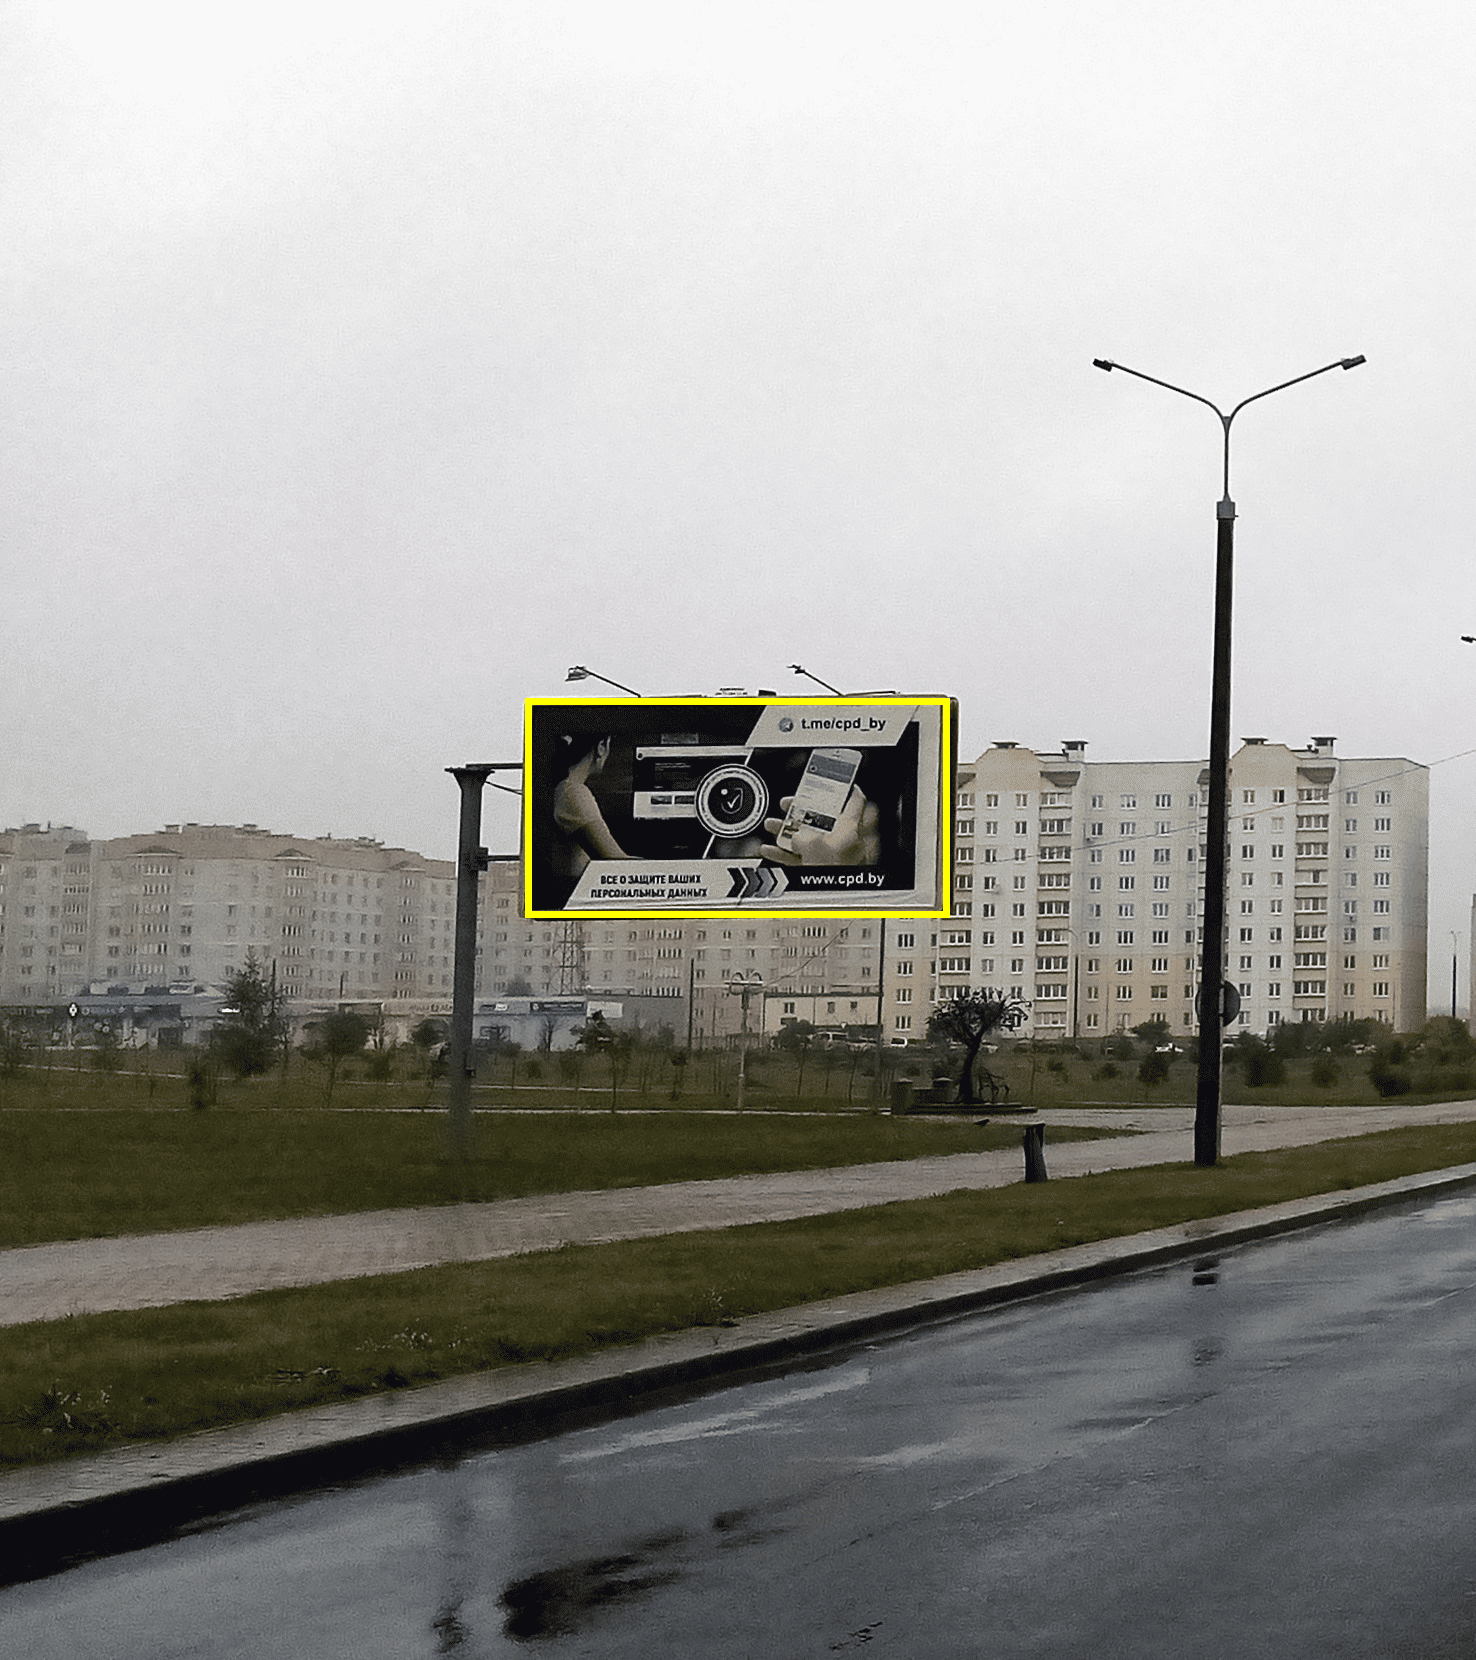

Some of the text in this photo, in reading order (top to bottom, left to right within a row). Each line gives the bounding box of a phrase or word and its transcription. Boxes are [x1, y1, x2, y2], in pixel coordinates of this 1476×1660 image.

[801, 717, 886, 731] t.me/cpd_by
[600, 874, 701, 885] ВСЕ О ЗАЩИТЕ ВАШИХ
[800, 872, 885, 887] www.cpd.by
[590, 888, 708, 899] ПЕРСОНАЛЬНЫХ ДАННЫХ
